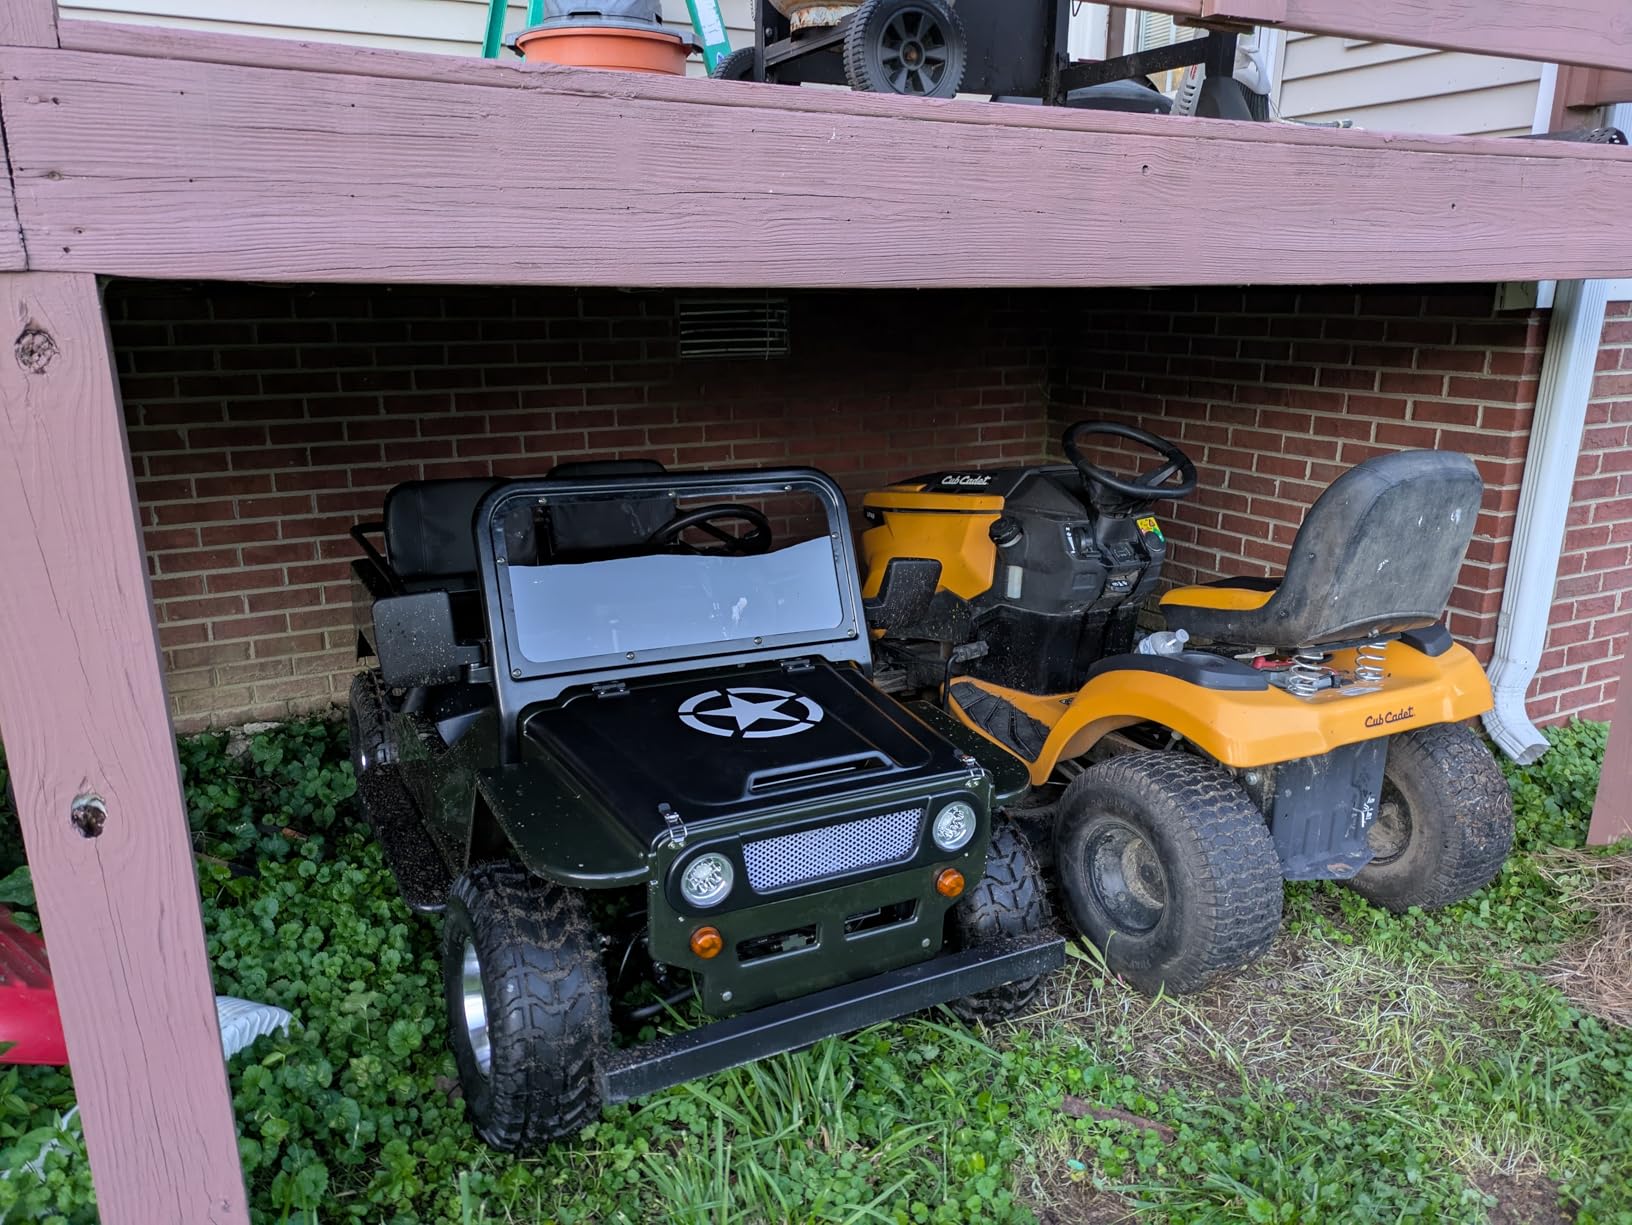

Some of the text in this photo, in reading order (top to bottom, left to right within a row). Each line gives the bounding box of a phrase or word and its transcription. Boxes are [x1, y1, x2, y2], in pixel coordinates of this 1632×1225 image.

[941, 475, 992, 485] Cub Cadet
[1365, 705, 1414, 728] Cub Cadet
